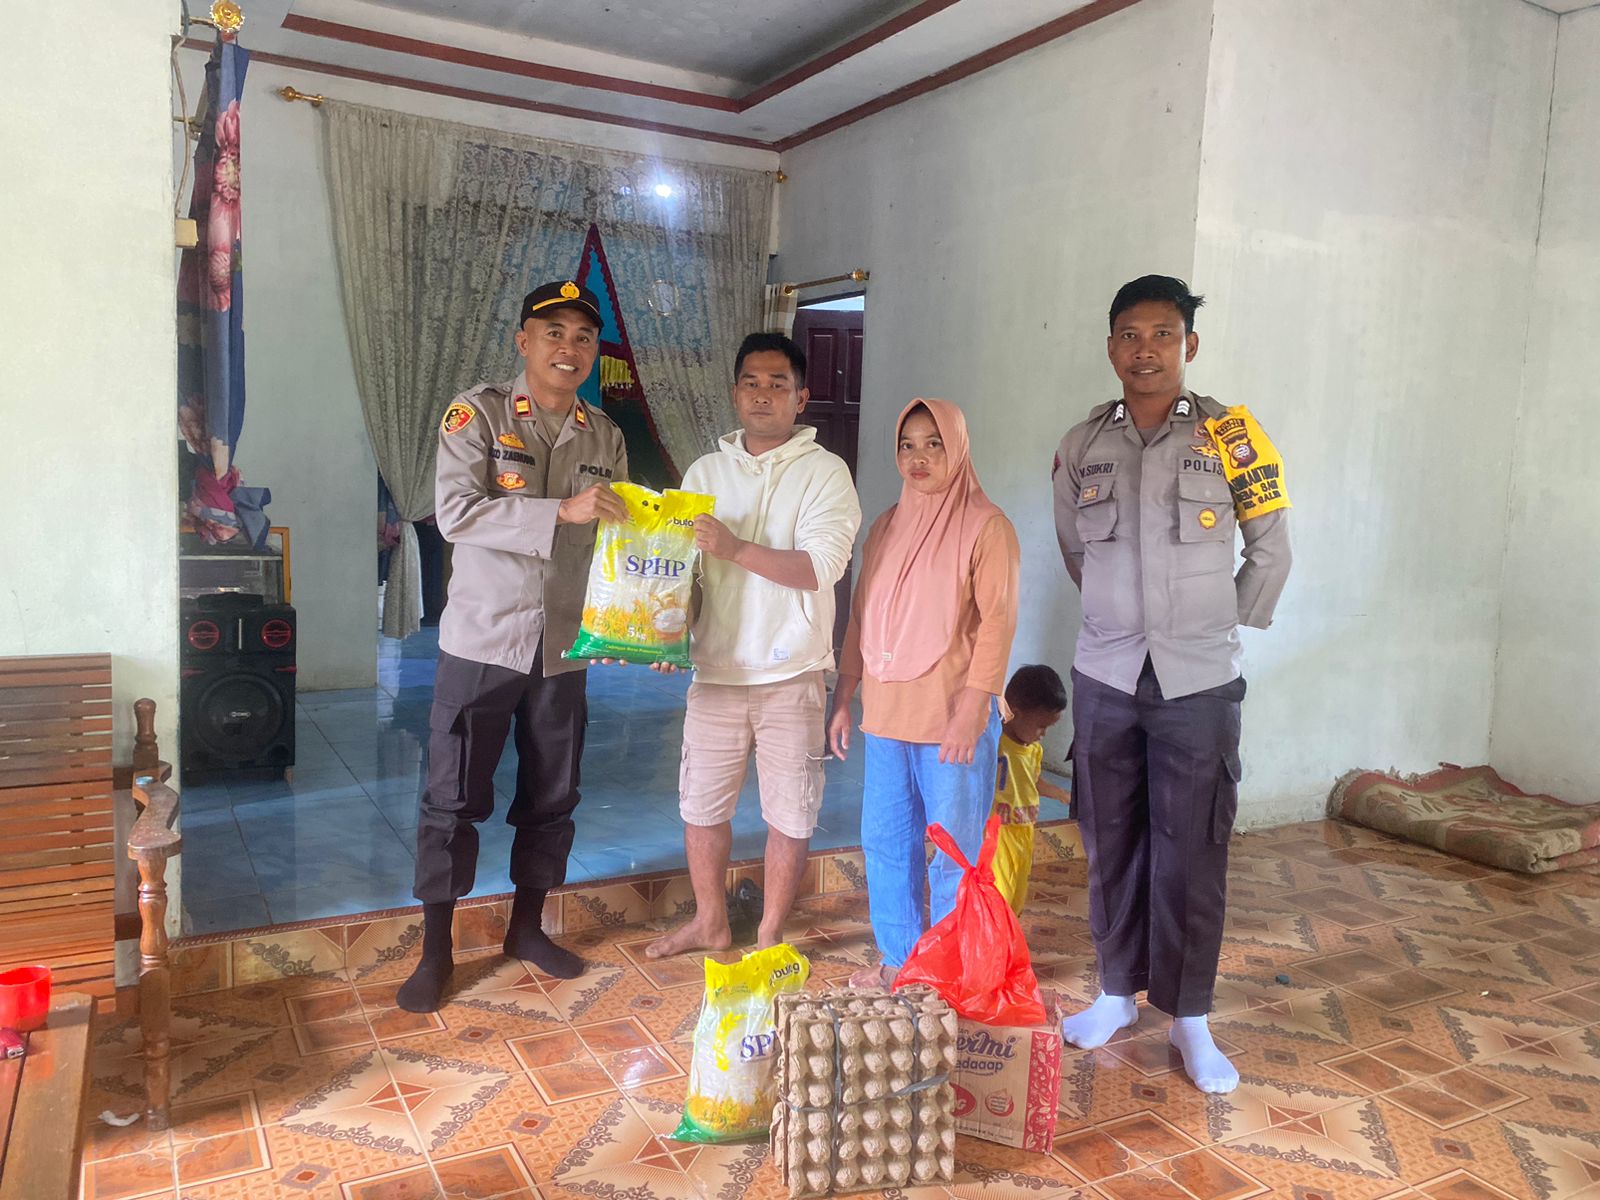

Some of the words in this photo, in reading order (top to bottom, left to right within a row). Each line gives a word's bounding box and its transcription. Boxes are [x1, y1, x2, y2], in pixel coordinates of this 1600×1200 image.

[1183, 458, 1224, 476] POLIS
[626, 554, 686, 577] SPHP
[740, 1030, 780, 1058] SP
